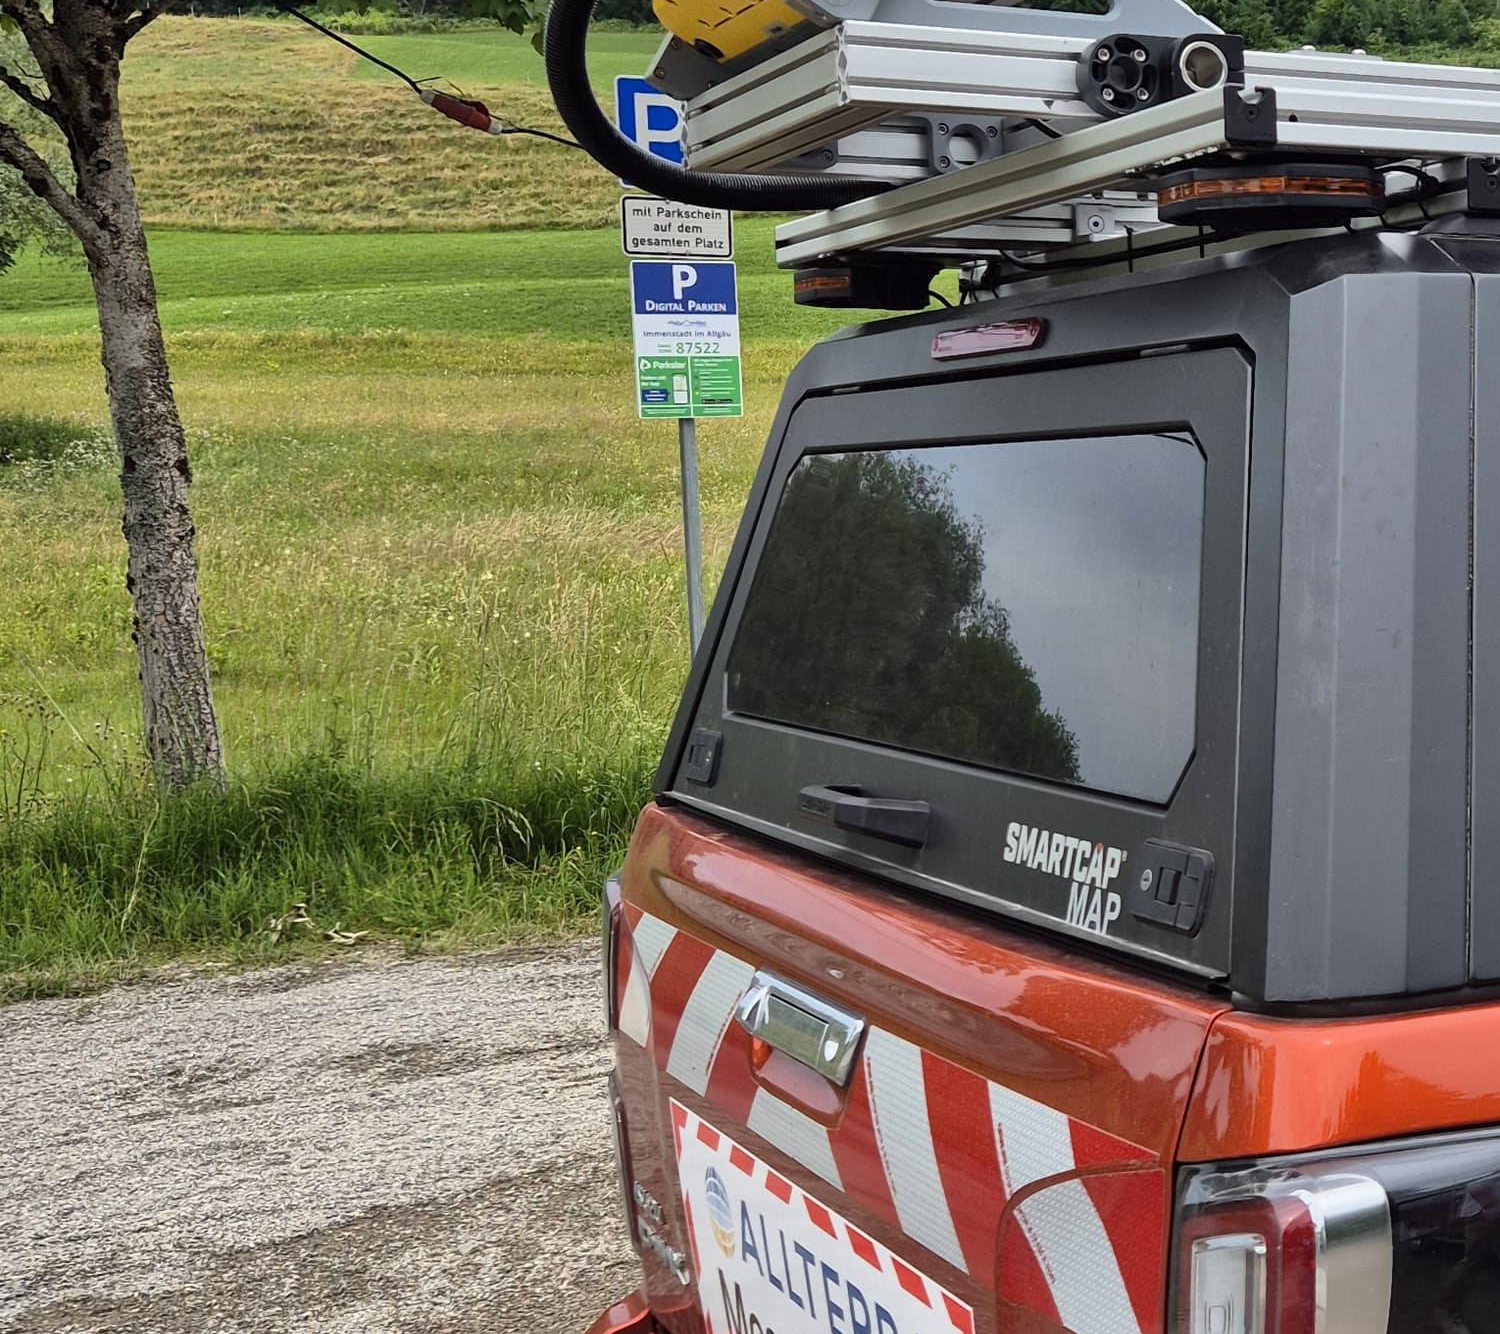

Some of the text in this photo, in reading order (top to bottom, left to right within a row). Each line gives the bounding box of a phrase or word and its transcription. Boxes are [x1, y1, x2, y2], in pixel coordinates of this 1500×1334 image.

[633, 92, 683, 154] P
[632, 207, 722, 220] mit Parkschein
[653, 222, 703, 234] auf dem
[632, 236, 724, 249] gesamten Platz
[671, 264, 697, 300] P
[645, 300, 727, 312] DIGITAL PARKEN
[643, 330, 731, 339] Immenstadt im Allgäu
[676, 342, 720, 354] 87522
[1064, 881, 1122, 936] MAP
